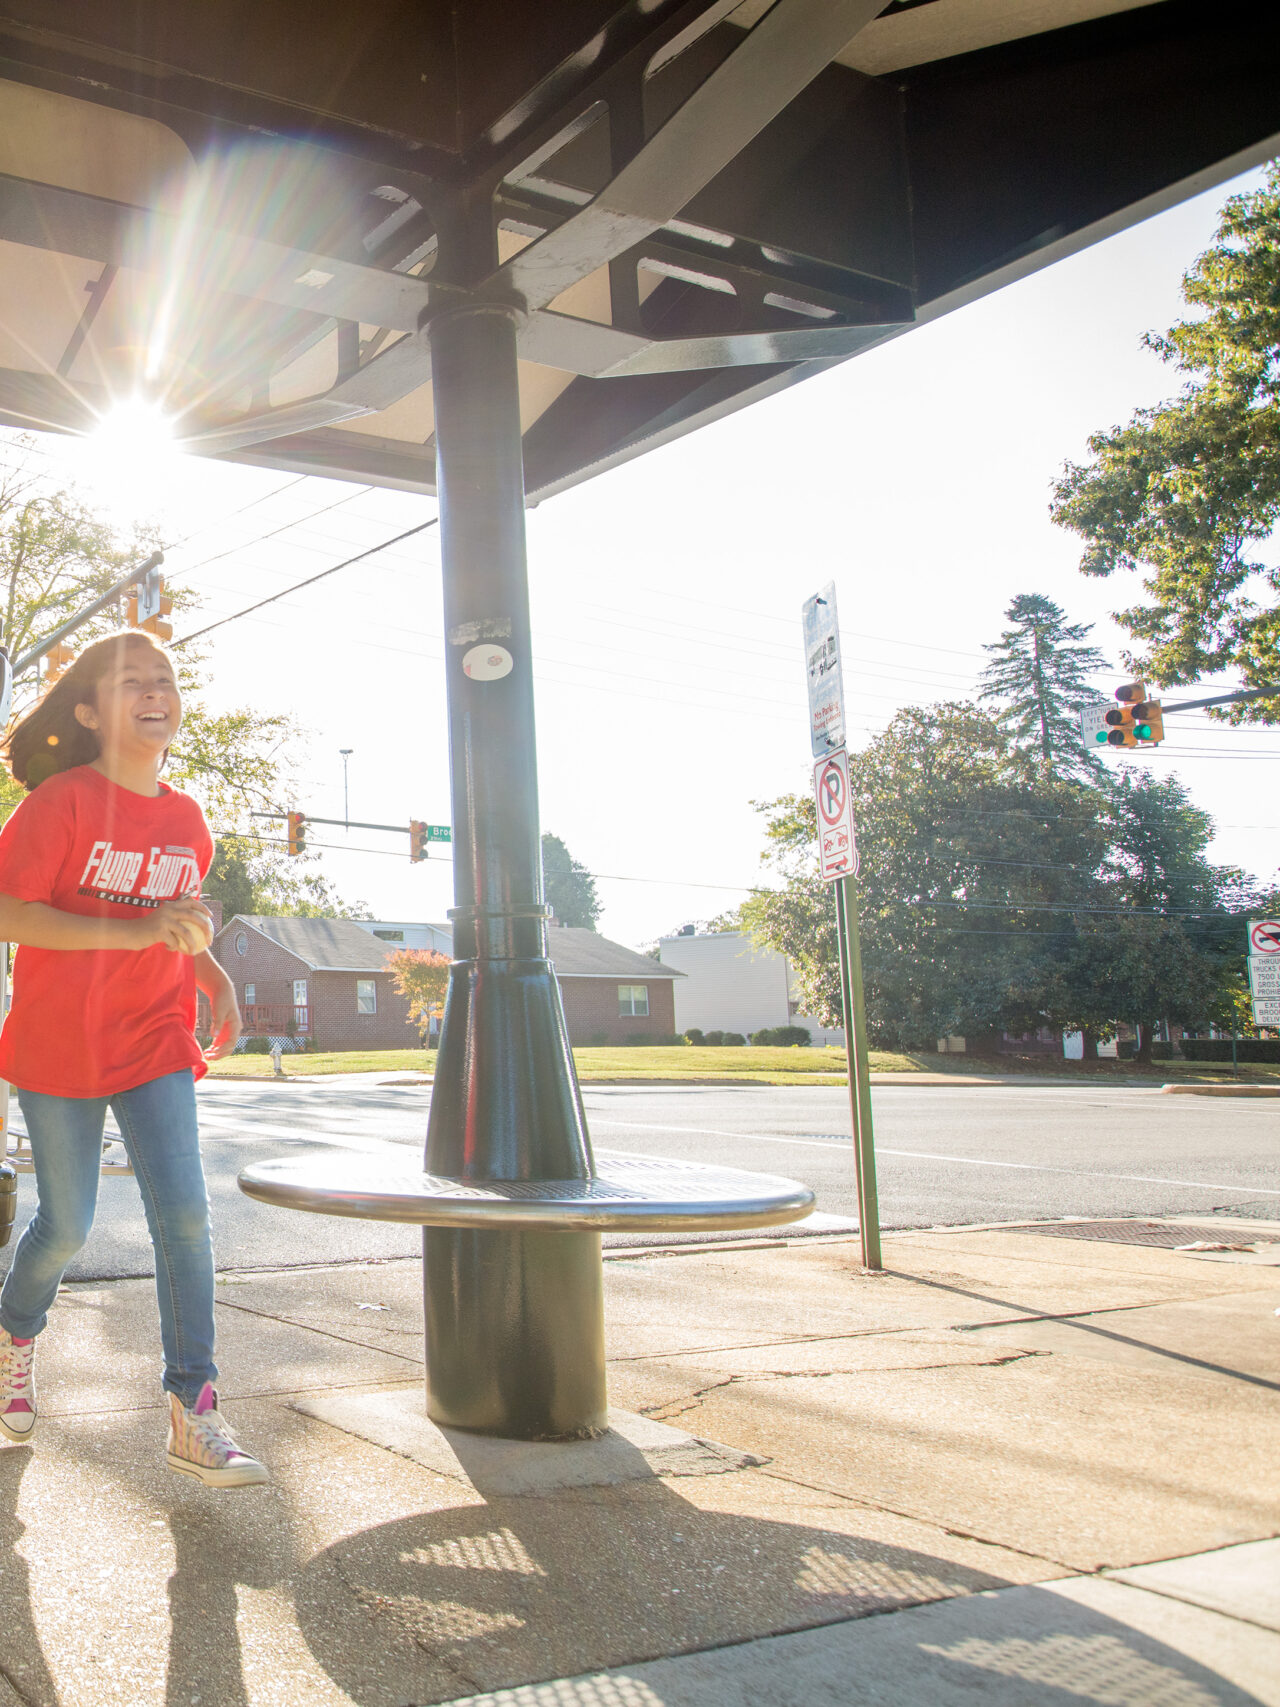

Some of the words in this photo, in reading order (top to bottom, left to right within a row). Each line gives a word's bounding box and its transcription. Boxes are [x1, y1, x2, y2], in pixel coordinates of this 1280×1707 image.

[1089, 715, 1107, 724] YIEL
[79, 841, 144, 893] Flying
[98, 892, 158, 908] BASEBALL
